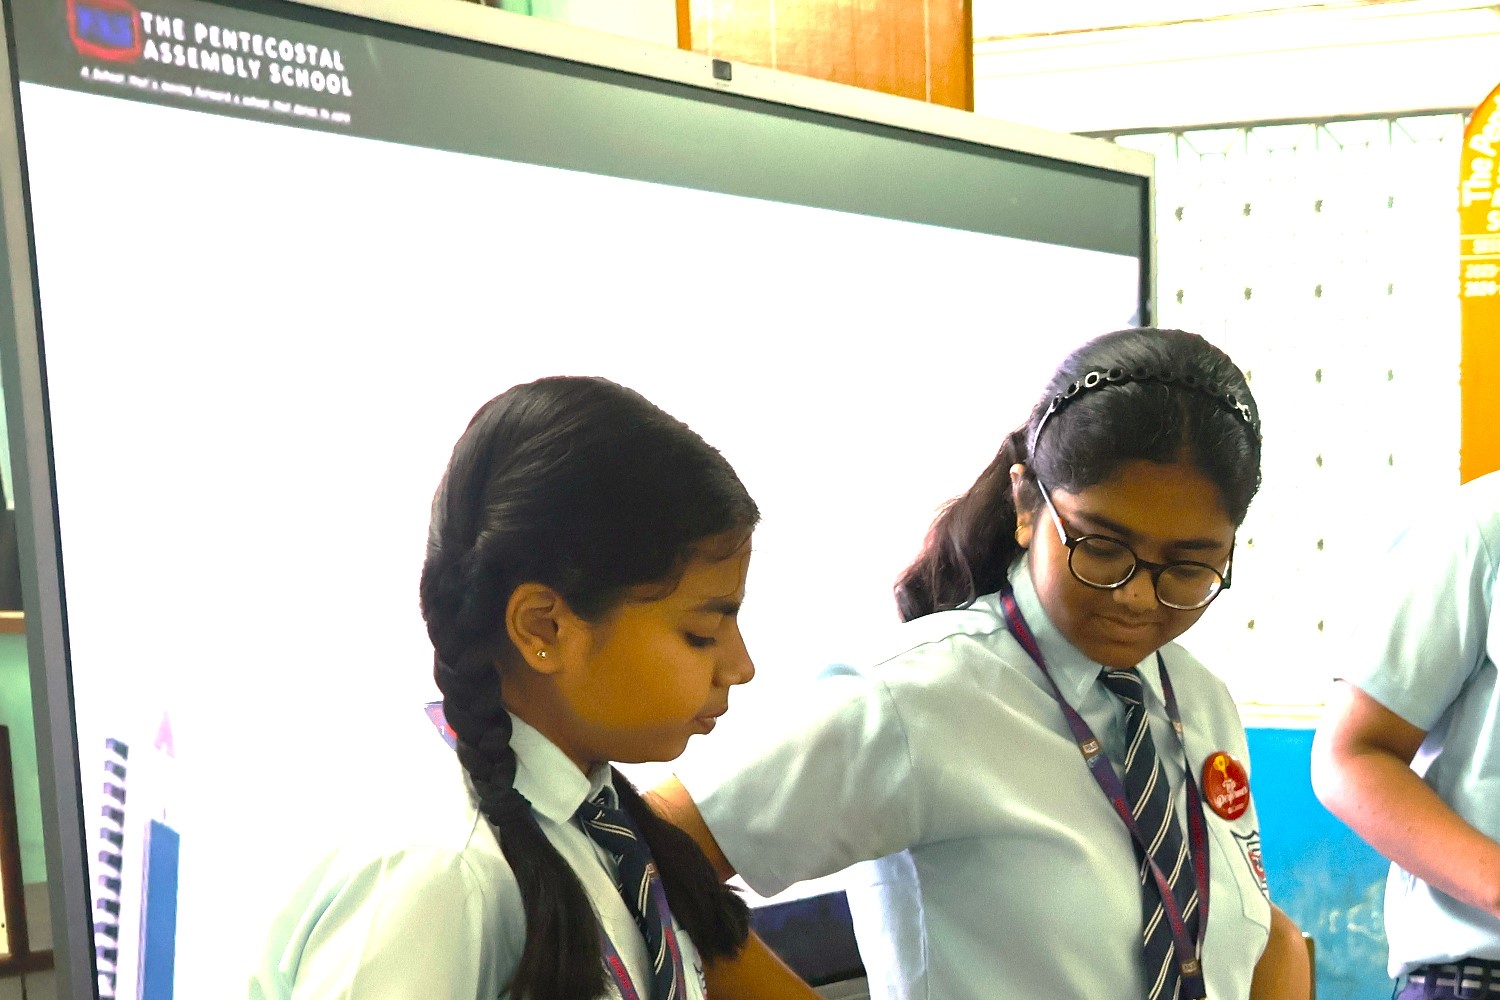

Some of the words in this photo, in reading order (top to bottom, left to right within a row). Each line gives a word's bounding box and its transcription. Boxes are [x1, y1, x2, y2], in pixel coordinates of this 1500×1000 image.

[140, 11, 184, 40] THE
[194, 23, 345, 71] PENTECOSTAL
[143, 39, 260, 79] ASSEMBLY
[269, 62, 352, 97] SCHOOL
[1462, 157, 1496, 207] The
